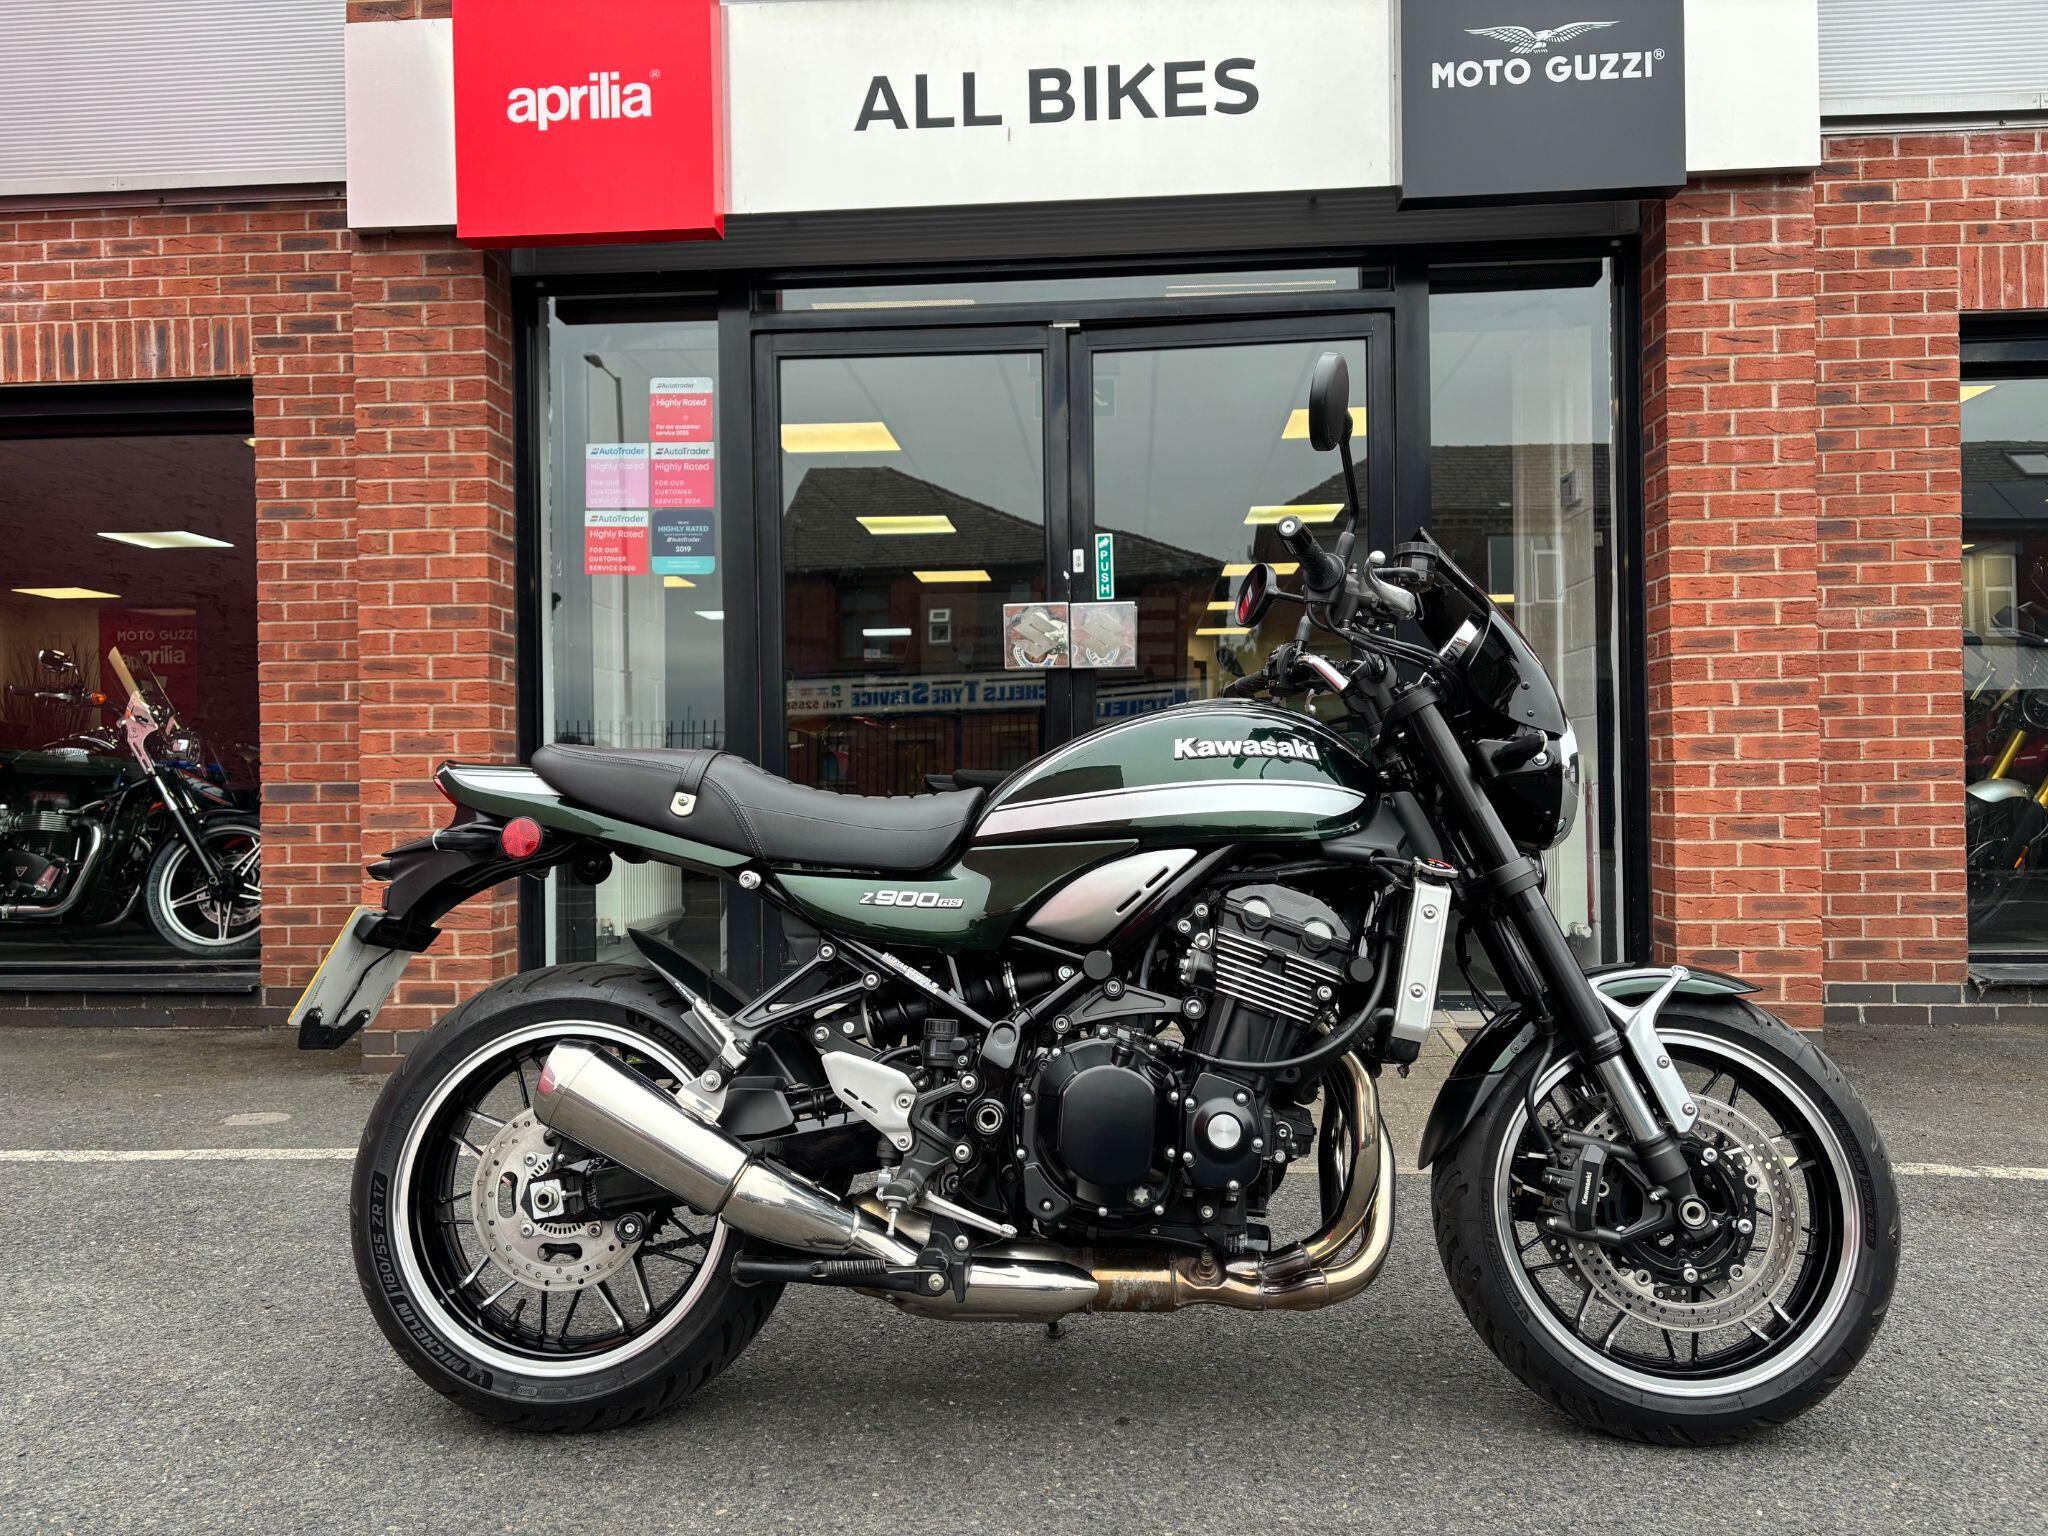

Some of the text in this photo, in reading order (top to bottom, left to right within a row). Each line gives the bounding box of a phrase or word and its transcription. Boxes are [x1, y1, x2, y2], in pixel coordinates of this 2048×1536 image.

[1432, 49, 1654, 89] MOTO GUZZI
[507, 71, 652, 131] aprilia
[854, 57, 1260, 132] ALL BIKES
[656, 398, 707, 408] Highly Rated
[599, 447, 644, 455] AutoTrader
[663, 447, 710, 455] AutoTrader
[655, 462, 710, 473] Highly Rated
[590, 529, 644, 539] Highly Rated
[599, 515, 644, 523] AutoTrader
[1100, 551, 1110, 594] PUSH
[117, 630, 155, 641] MOTO
[1173, 737, 1320, 762] Kawasaki
[653, 1026, 707, 1071] MICHE
[1581, 1171, 1593, 1206] Kawasaki
[372, 1178, 398, 1294] 180/55 ZR 17
[395, 1302, 468, 1373] MICHELIN
